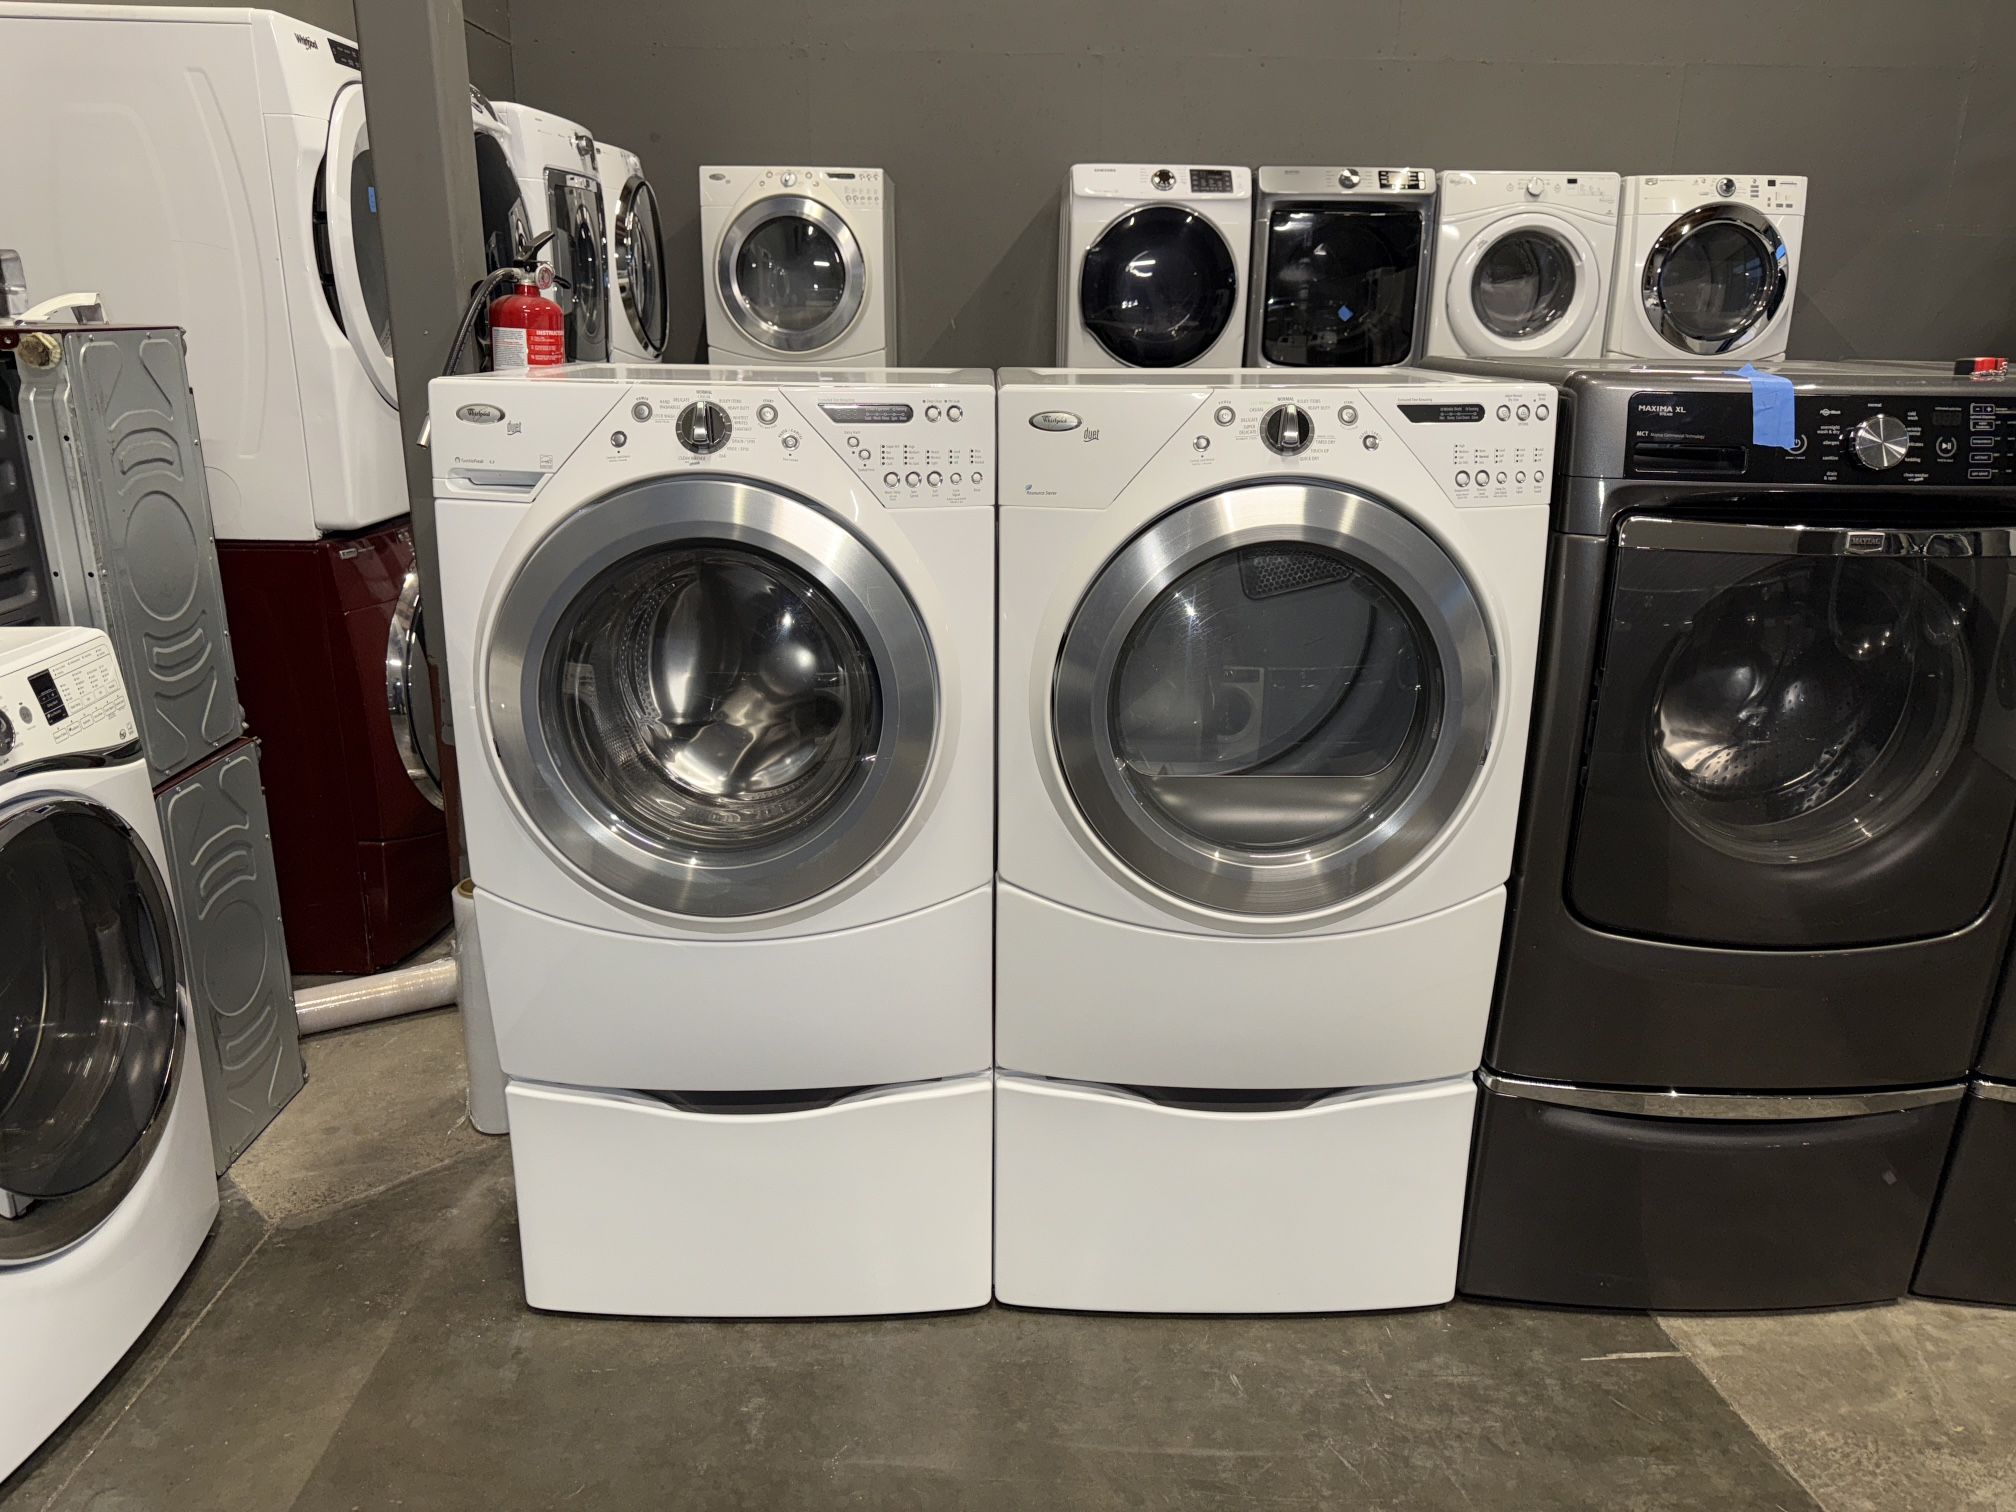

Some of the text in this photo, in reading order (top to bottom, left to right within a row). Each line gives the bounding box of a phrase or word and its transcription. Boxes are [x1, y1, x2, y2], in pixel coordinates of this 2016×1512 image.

[294, 32, 319, 50] Whirlpool
[466, 408, 490, 418] Whirlpool
[1042, 415, 1067, 424] Whirlpool
[1084, 427, 1100, 442] duet
